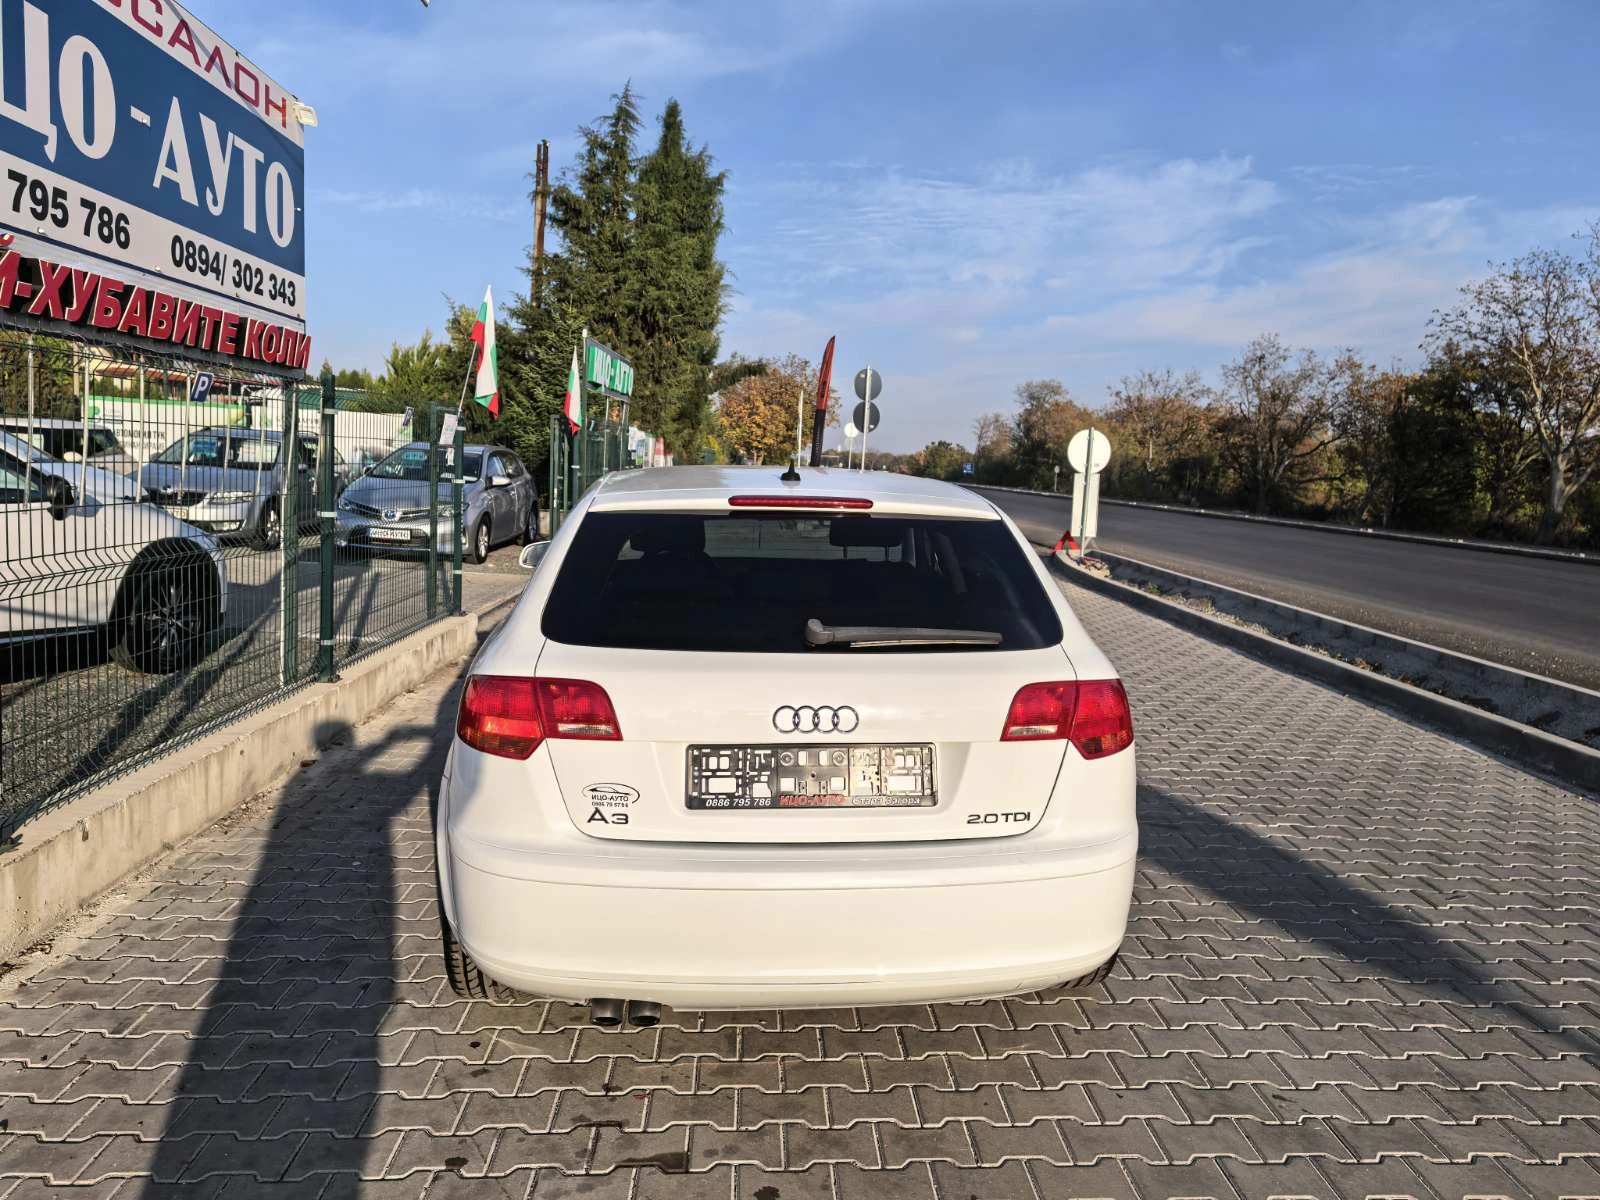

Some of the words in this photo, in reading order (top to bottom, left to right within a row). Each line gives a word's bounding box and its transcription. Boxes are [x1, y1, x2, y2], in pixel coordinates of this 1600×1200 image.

[107, 0, 287, 129] САЛОН
[7, 168, 69, 228] 795
[79, 197, 131, 250] 786
[231, 258, 264, 296] 302
[268, 275, 297, 307] 343
[243, 317, 312, 369] КОЛИ
[587, 807, 629, 825] A3
[705, 798, 730, 807] 0886
[733, 798, 751, 807] 795
[753, 798, 771, 806] 786
[967, 813, 998, 824] 2.0
[1000, 811, 1031, 823] TDI
